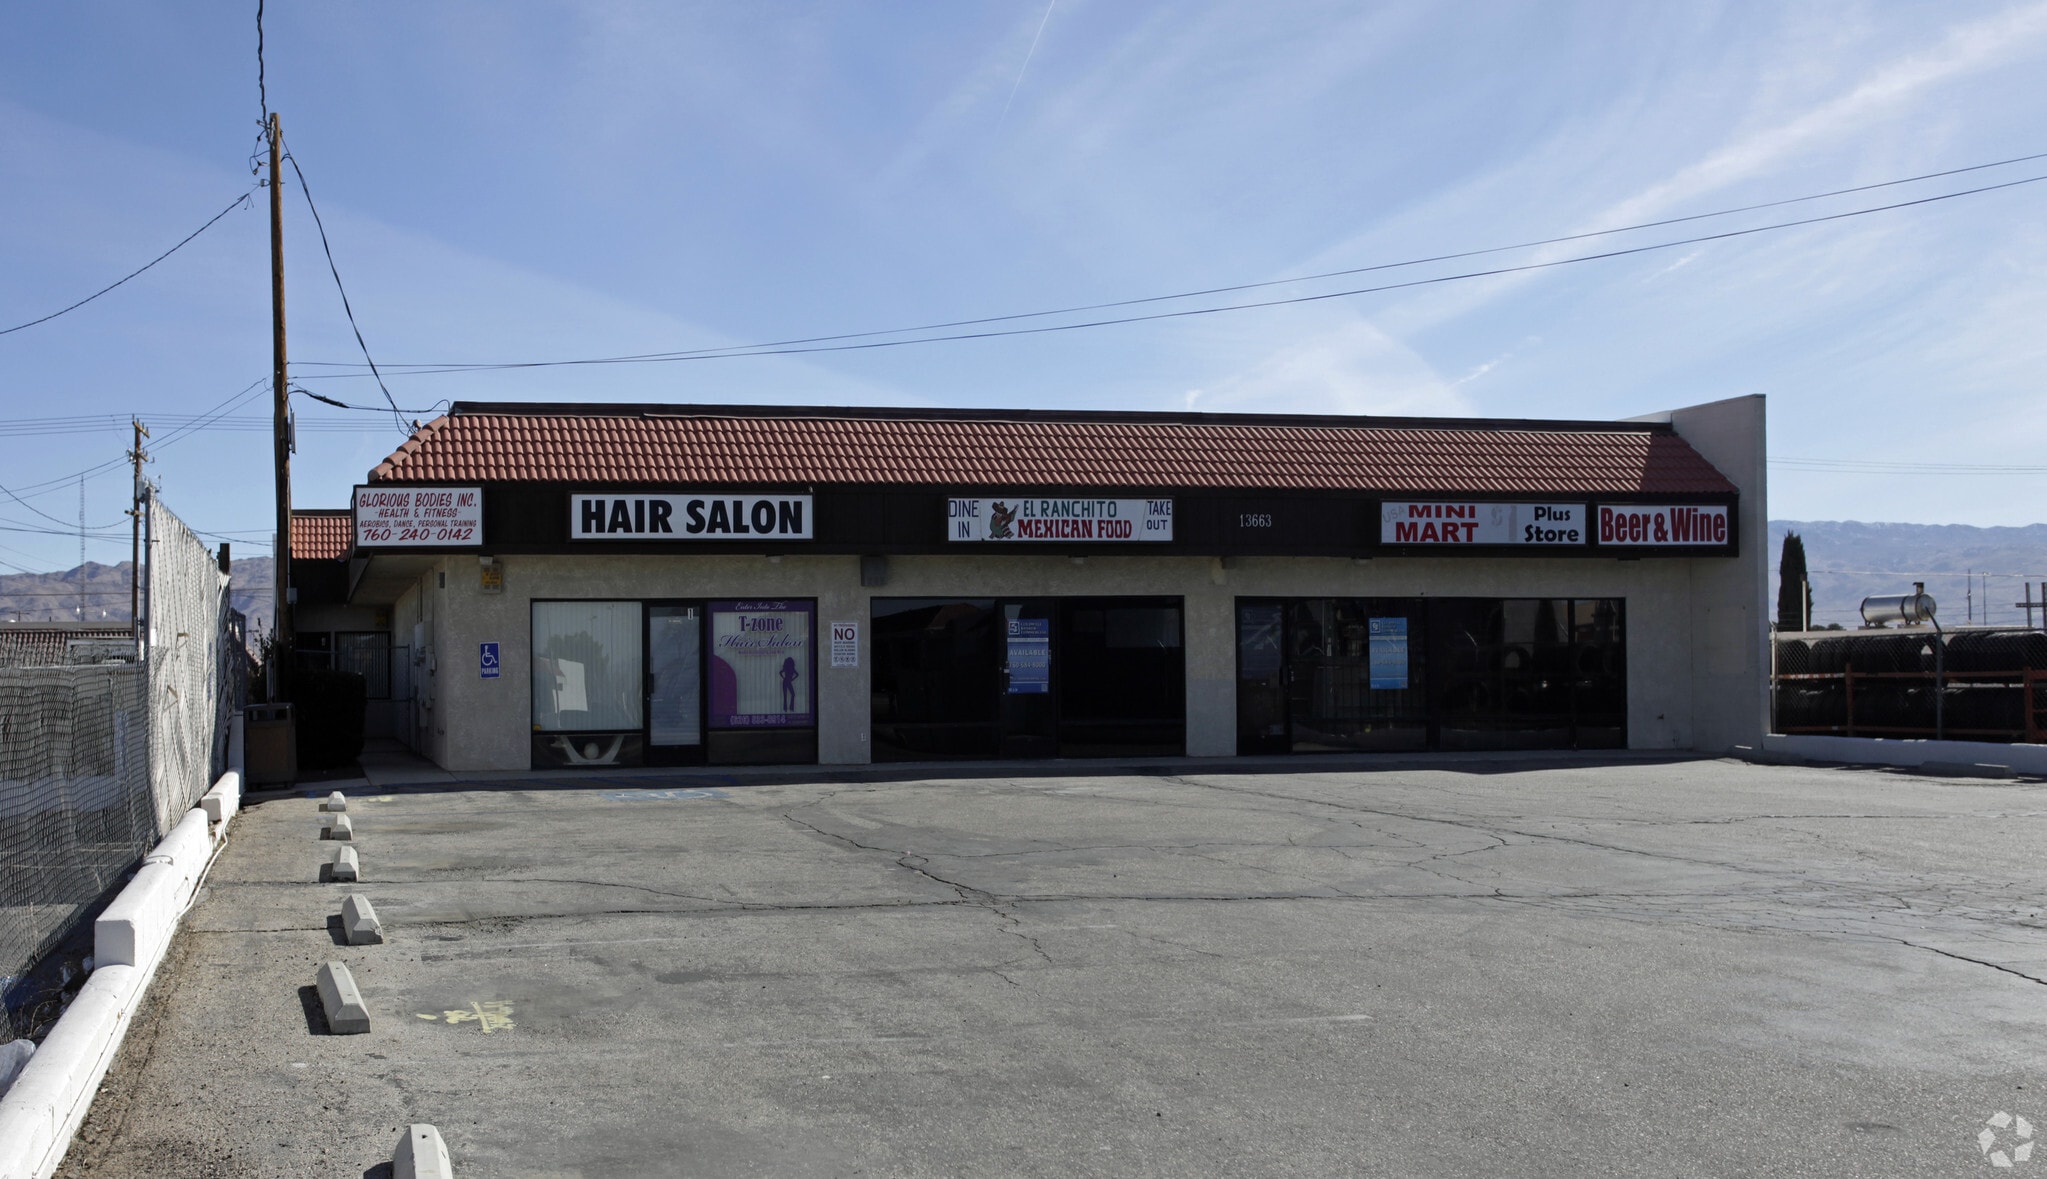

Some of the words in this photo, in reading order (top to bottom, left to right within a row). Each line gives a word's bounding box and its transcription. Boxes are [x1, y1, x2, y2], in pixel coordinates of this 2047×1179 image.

[359, 493, 410, 508] GLORIOUS
[414, 493, 453, 508] BODIES
[456, 493, 477, 508] INC.
[1147, 500, 1172, 516] TAKE
[413, 508, 420, 518] &
[949, 500, 979, 518] DINE
[1023, 500, 1036, 518] EL
[1040, 500, 1117, 518] RANCHITO
[1408, 504, 1476, 519] MINI
[1534, 506, 1571, 522] Plus
[359, 520, 392, 529] AEROBICS,
[393, 520, 416, 529] DANCE,
[417, 520, 448, 528] PERSONAL
[450, 520, 477, 528] TRAINING
[581, 499, 674, 534] HAIR
[686, 499, 803, 535] SALON
[1146, 519, 1168, 530] OUT
[1239, 514, 1272, 528] 13663
[363, 528, 473, 541] 760-240-0142
[958, 521, 970, 538] IN
[1017, 519, 1093, 539] MEXICAN
[1097, 519, 1133, 539] FOOD
[1395, 521, 1479, 543] MART
[1524, 524, 1579, 543] Store
[771, 601, 787, 610] The
[738, 615, 784, 632] T-zone
[718, 634, 756, 648] Hair
[757, 633, 803, 648] Salon
[834, 627, 855, 641] NO
